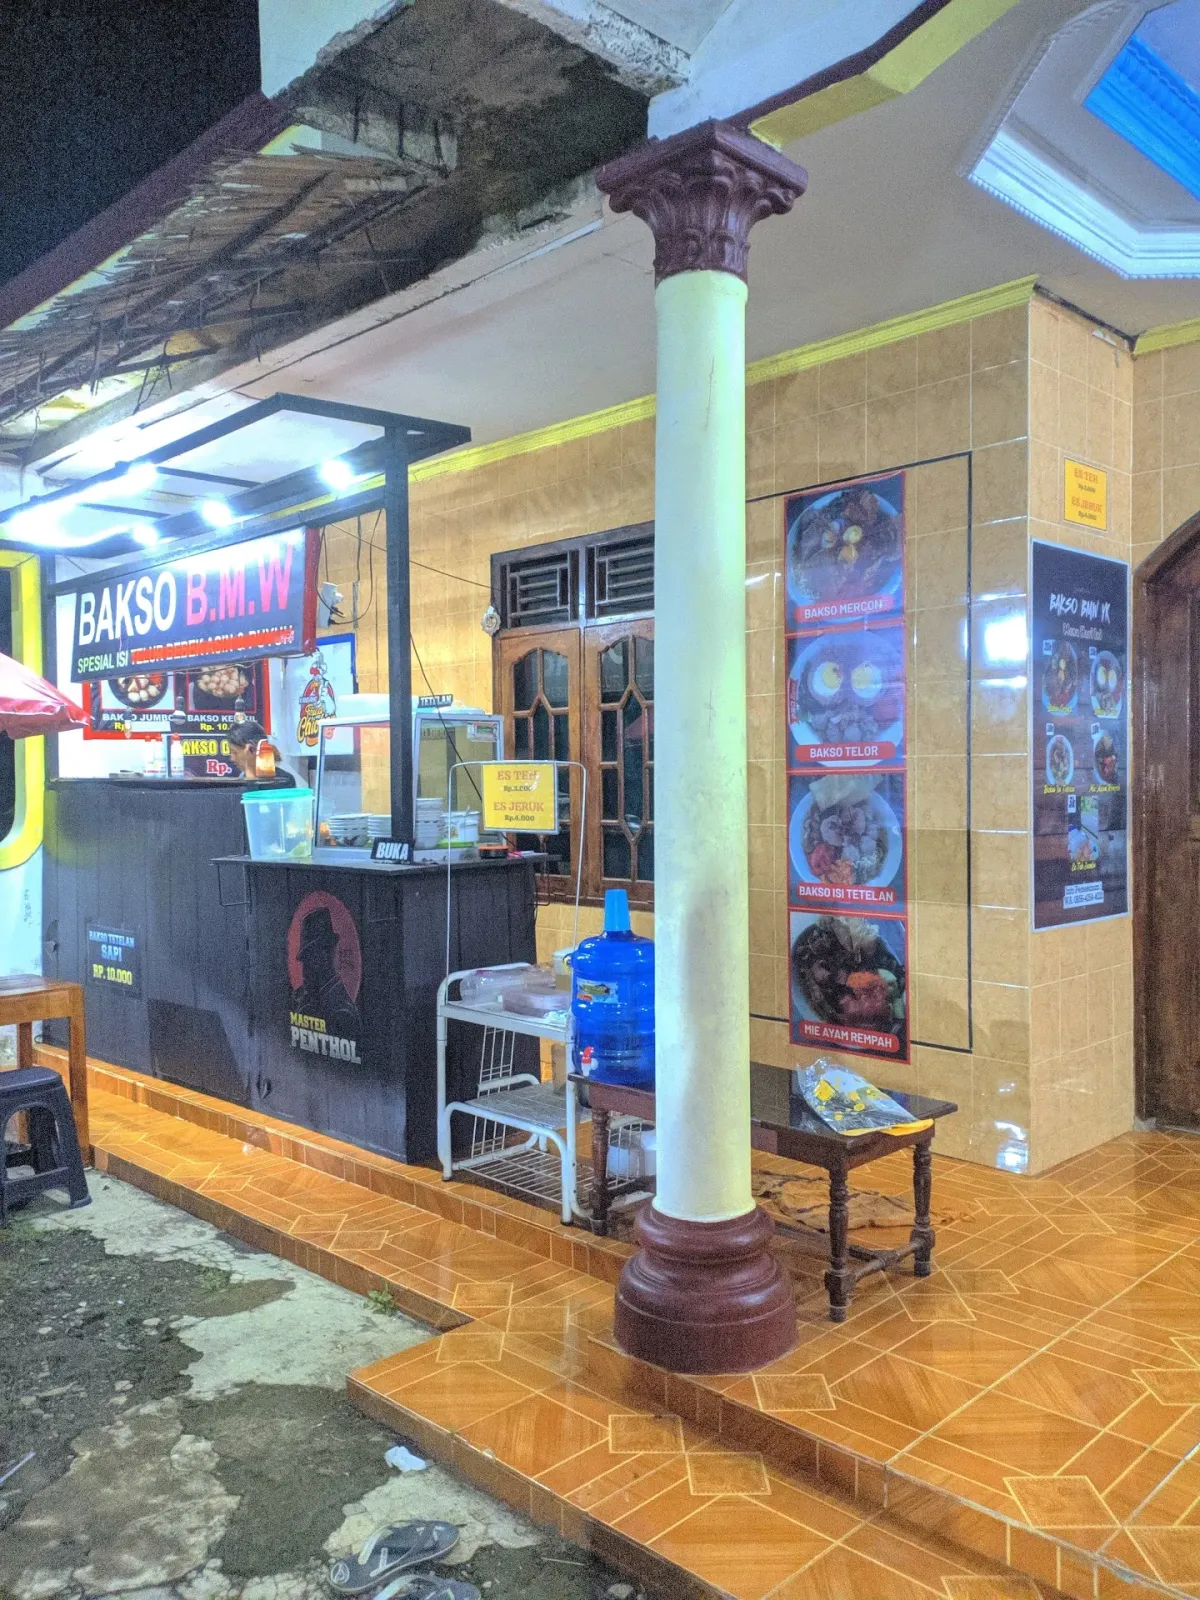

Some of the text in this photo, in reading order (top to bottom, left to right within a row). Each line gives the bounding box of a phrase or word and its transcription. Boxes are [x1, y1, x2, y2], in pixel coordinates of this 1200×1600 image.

[79, 571, 177, 646] BAKSO
[186, 543, 294, 626] B.M.W
[804, 599, 883, 619] BAKSO MERCON
[1049, 592, 1078, 617] BAKSO
[1080, 599, 1100, 621] BMW
[77, 650, 129, 674] SPESIAL ISI
[102, 713, 137, 721] BAKO
[187, 714, 258, 723] BAKSO KEKIL
[199, 722, 215, 732] Rp.
[182, 740, 217, 755] AKSO
[810, 745, 879, 759] BAKSO TELOR
[207, 760, 232, 776] Rp.
[497, 770, 539, 781] ES TEH
[493, 801, 544, 812] ES JERUK
[504, 814, 535, 822] Rp.4.000
[376, 842, 409, 860] BUKA
[799, 885, 894, 901] BAKSO ISI TETELAN
[89, 930, 135, 948] BAKSO TETELAN
[101, 944, 122, 962] SAPI
[93, 963, 133, 985] RP. 10.000
[290, 1011, 326, 1033] MASTER
[290, 1025, 361, 1064] PENTHOL
[804, 1024, 892, 1048] MIE AYAM REMPAH
